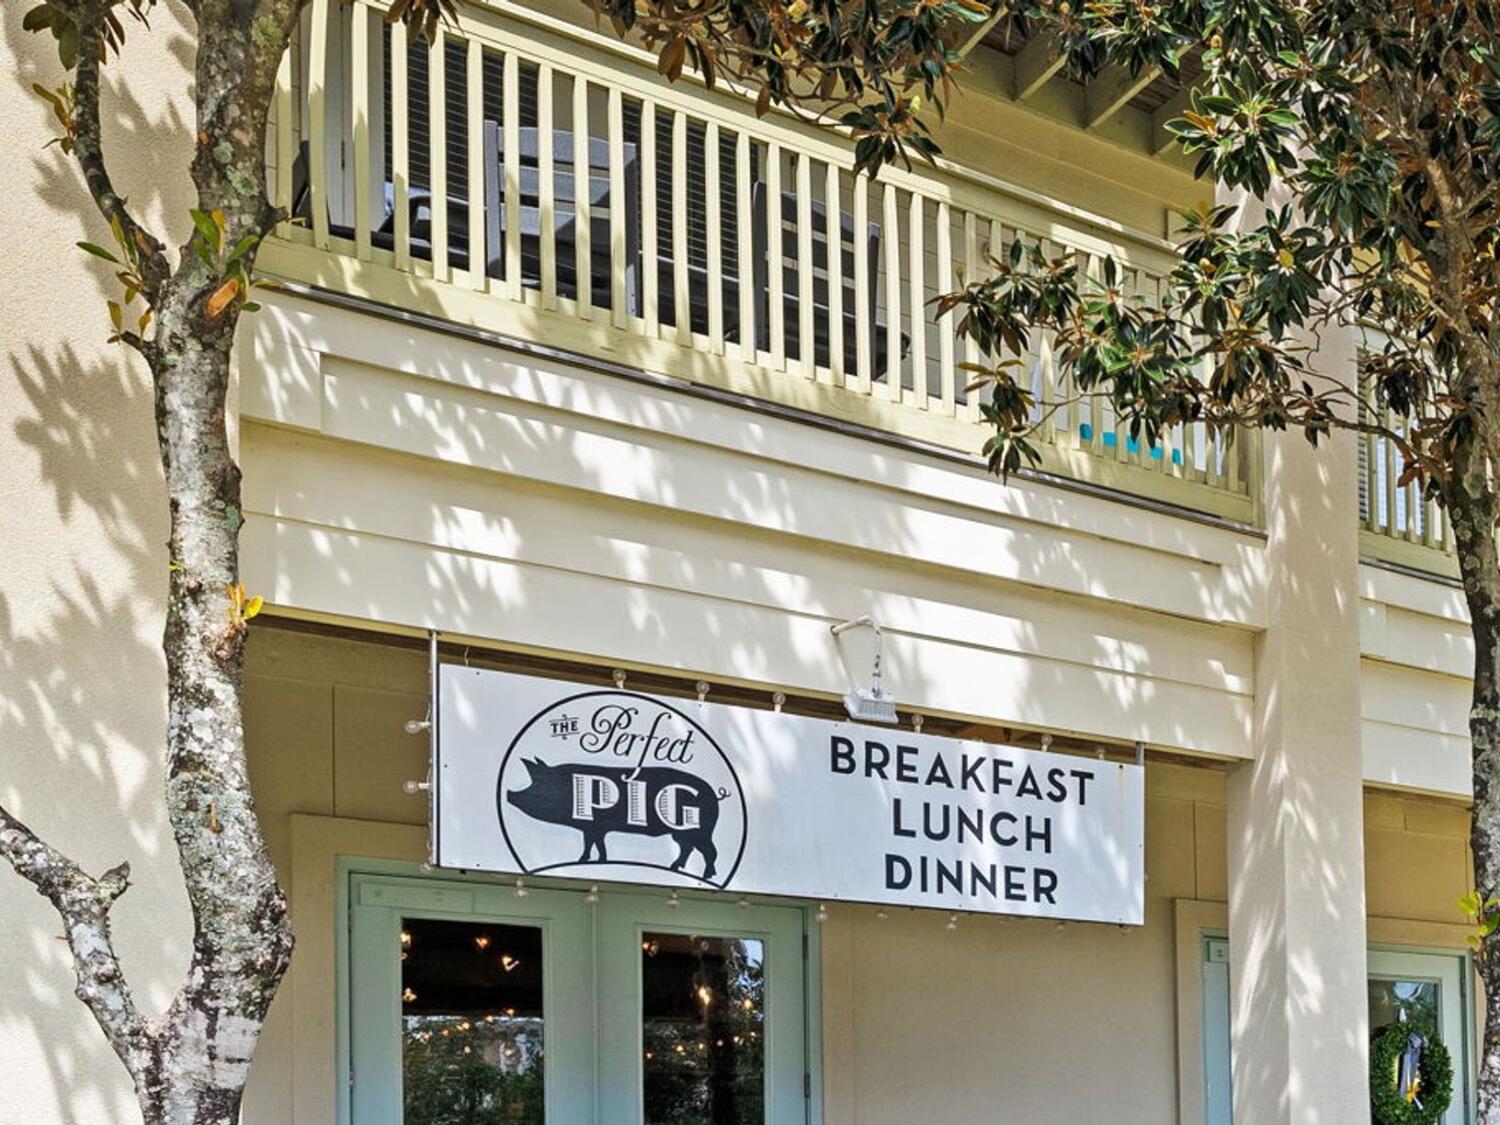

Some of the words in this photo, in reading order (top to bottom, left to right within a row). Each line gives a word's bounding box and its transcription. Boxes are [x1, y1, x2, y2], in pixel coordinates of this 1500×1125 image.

[550, 720, 579, 734] THE
[580, 704, 695, 782] Perfect
[830, 735, 1094, 806] BREAKFAST
[572, 772, 701, 830] PIG
[892, 798, 1052, 854] LUNCH
[885, 853, 1058, 905] DINNER
